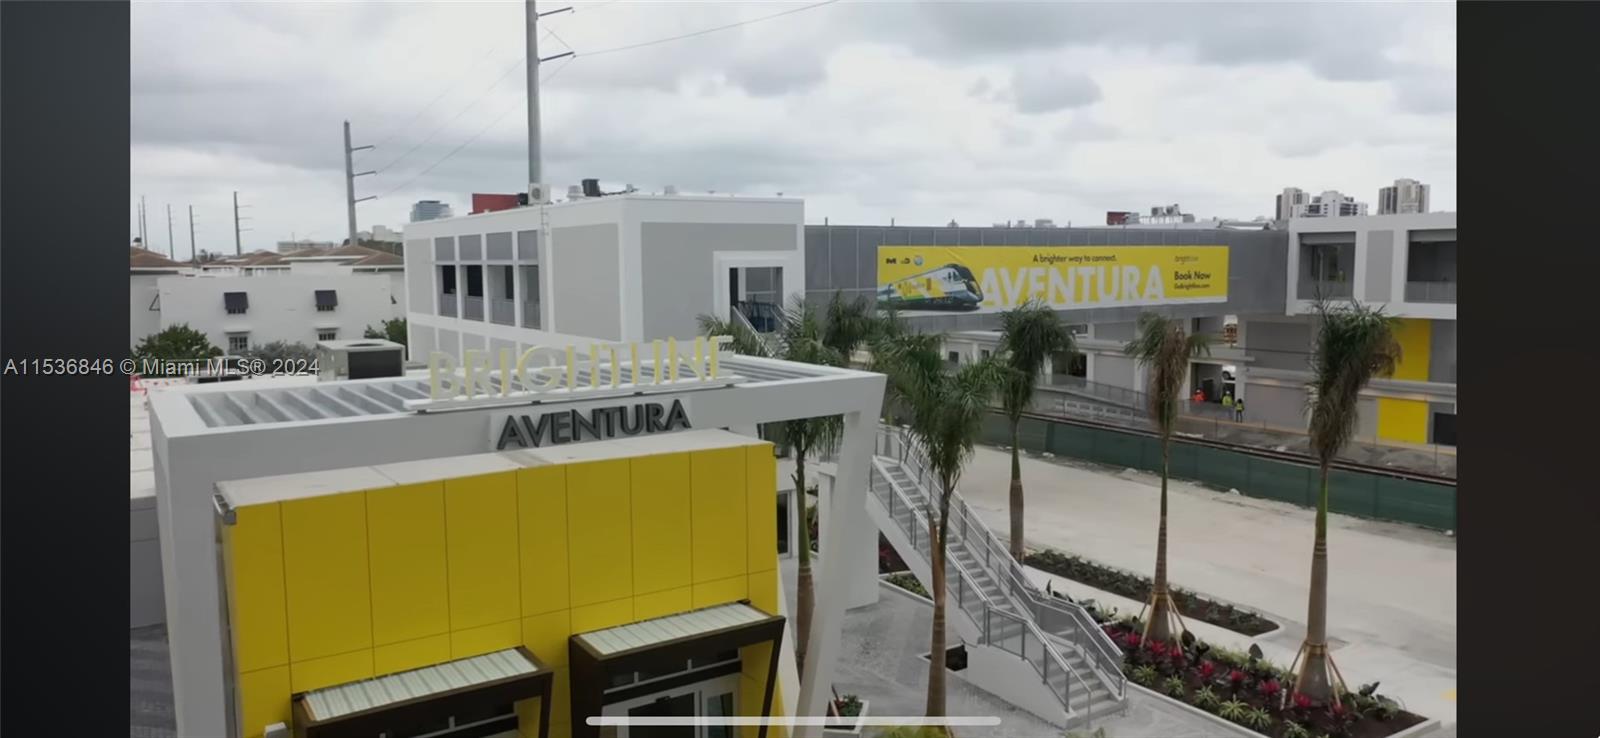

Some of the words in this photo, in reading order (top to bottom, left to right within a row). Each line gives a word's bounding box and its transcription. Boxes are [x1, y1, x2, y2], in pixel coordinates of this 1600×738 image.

[1033, 254, 1039, 263] A
[1040, 255, 1067, 264] brighter
[1068, 256, 1083, 264] way
[1174, 271, 1192, 281] Book
[1194, 271, 1211, 280] Now
[981, 265, 1165, 307] AVENTURA
[429, 334, 734, 401] BRIGHTLINE
[496, 399, 693, 451] AVENTURA
